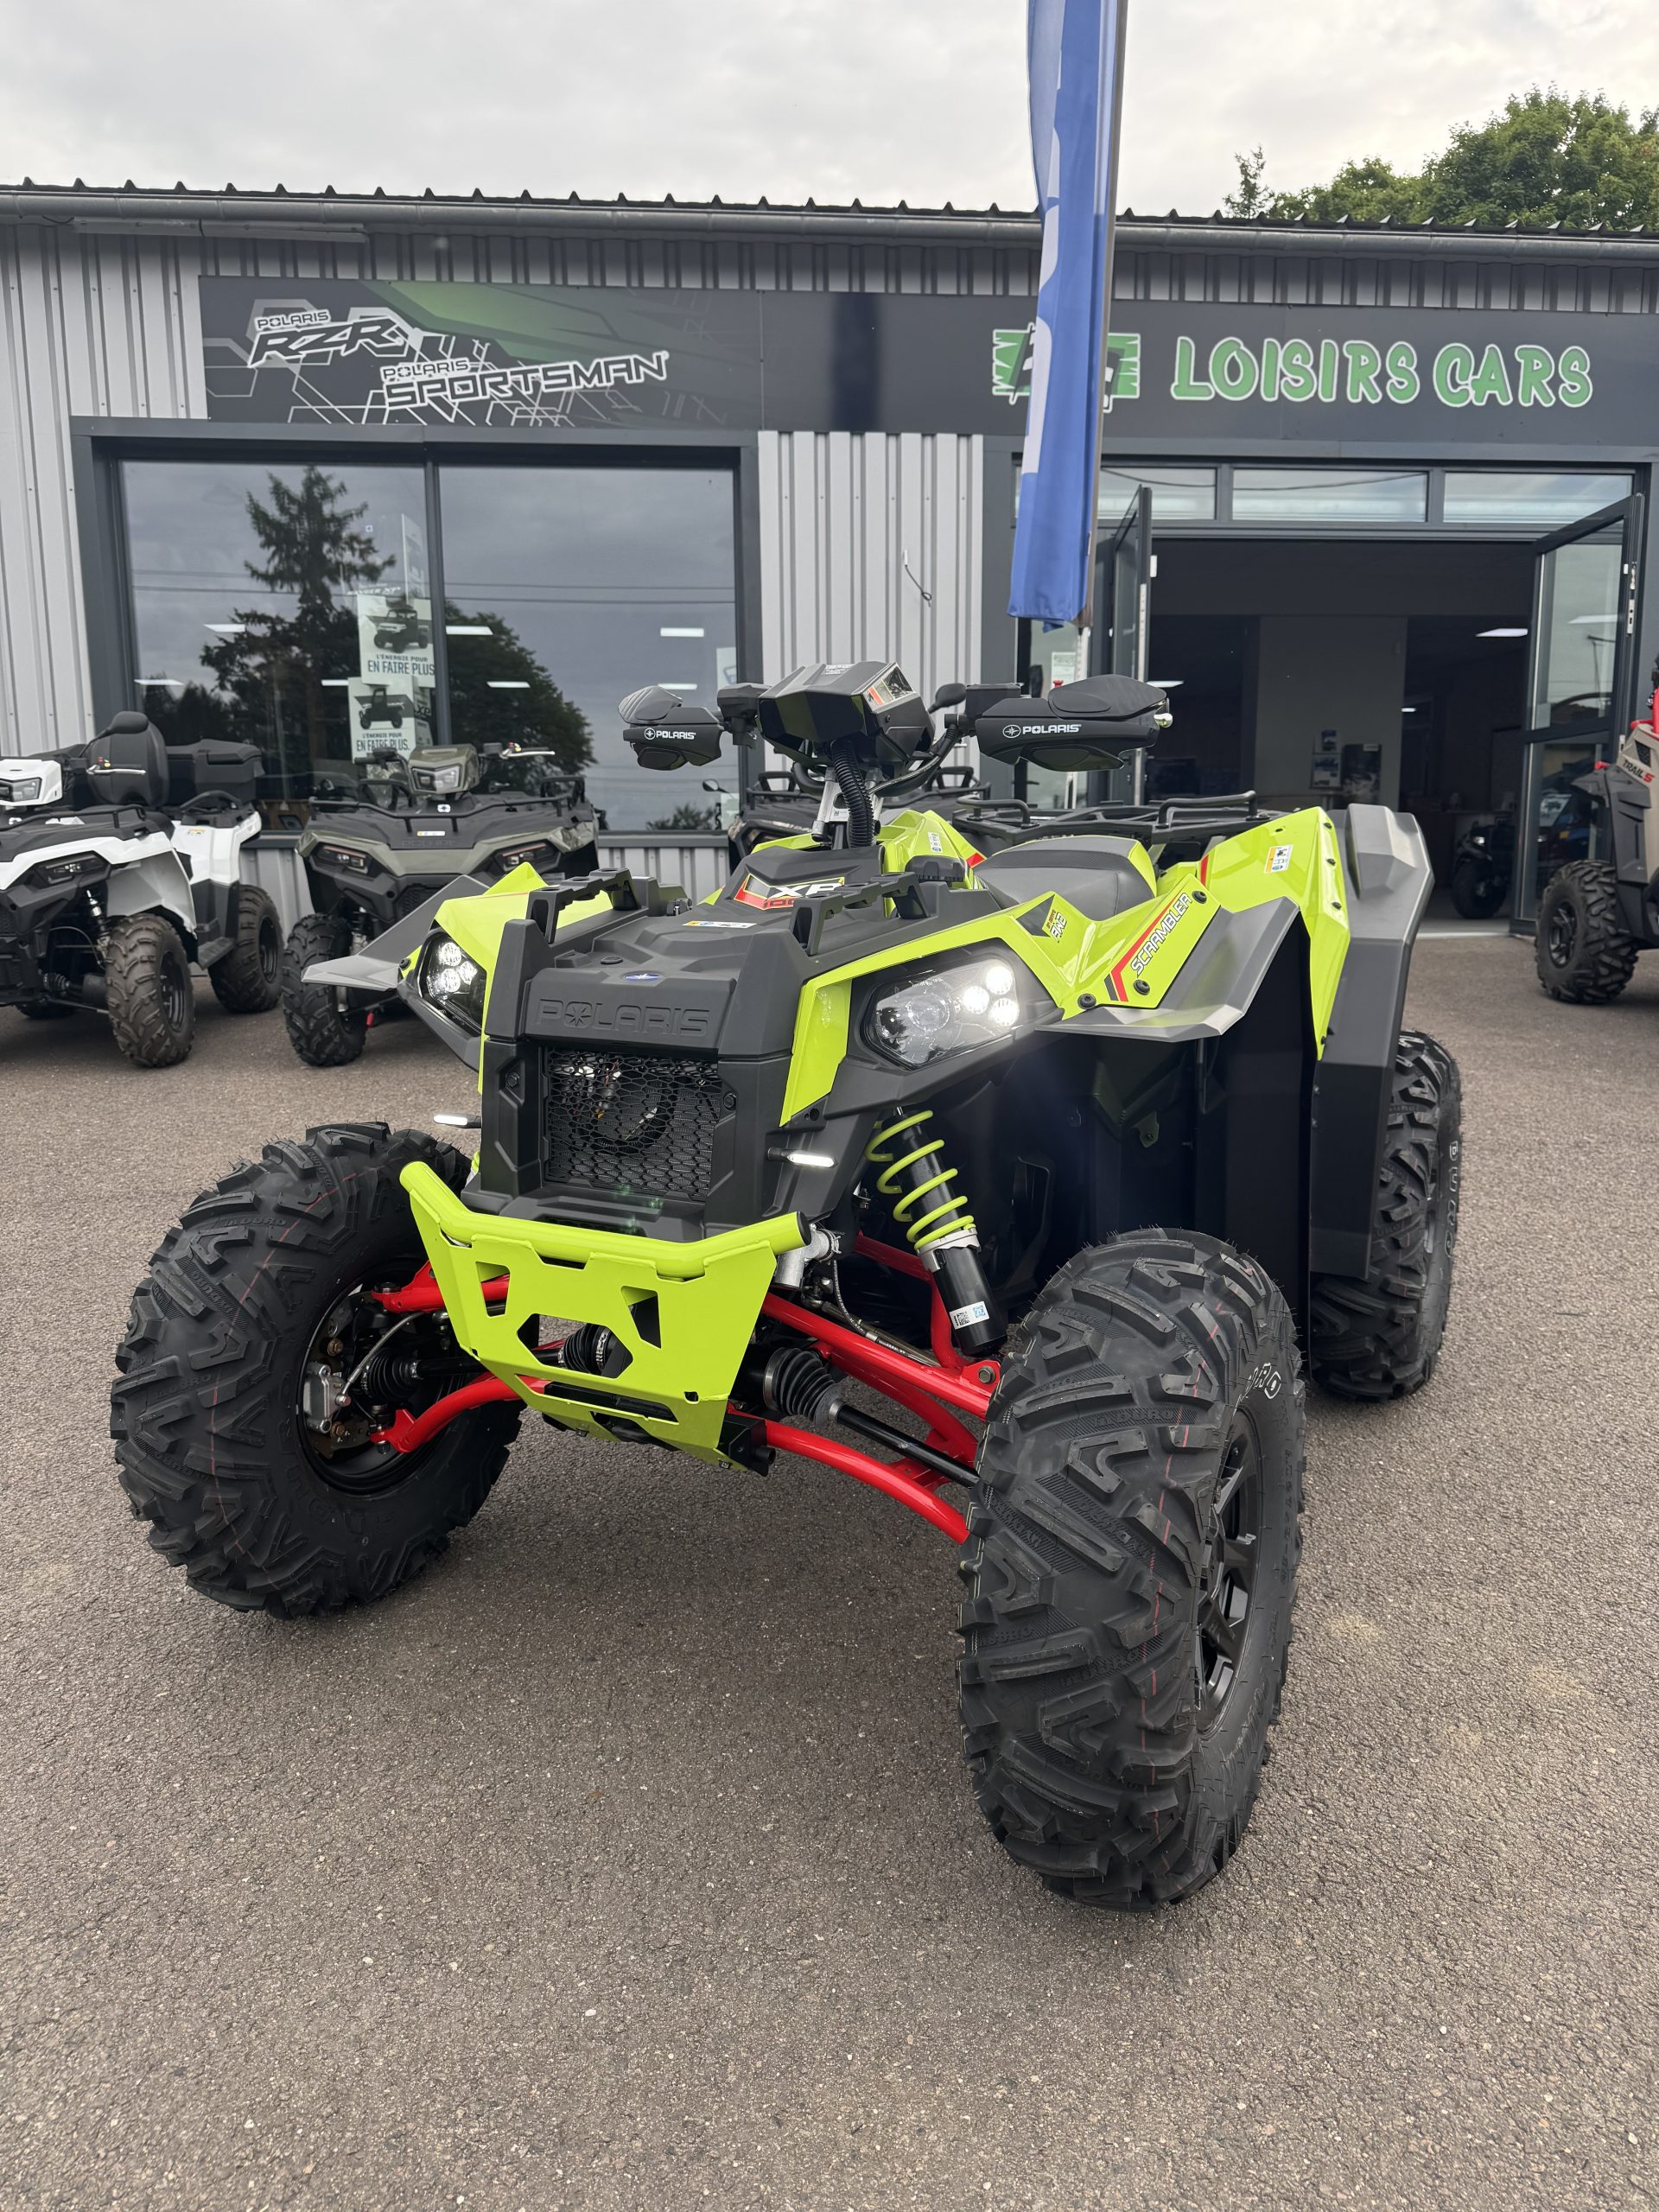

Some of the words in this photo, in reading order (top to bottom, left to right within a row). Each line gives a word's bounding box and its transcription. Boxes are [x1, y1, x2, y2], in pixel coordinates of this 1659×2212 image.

[257, 310, 330, 330] POLARIS
[249, 316, 400, 367] RZR
[382, 359, 469, 380] POLARIS
[1171, 336, 1420, 404] LOISIRS
[1433, 343, 1593, 407] CARS
[385, 352, 667, 410] SPORTSMAN
[367, 660, 380, 672] EN
[383, 661, 410, 675] FAIRE
[412, 663, 435, 676] PLUS
[656, 730, 696, 740] POLARIS
[1022, 724, 1082, 734] POLARIS
[357, 740, 366, 751] EN
[1623, 760, 1643, 779] TRAIL
[1643, 772, 1656, 783] S
[767, 883, 843, 899] XP
[1049, 912, 1068, 943] AWD
[1130, 893, 1192, 977] SCRAMBLER
[536, 997, 710, 1036] POLARIS
